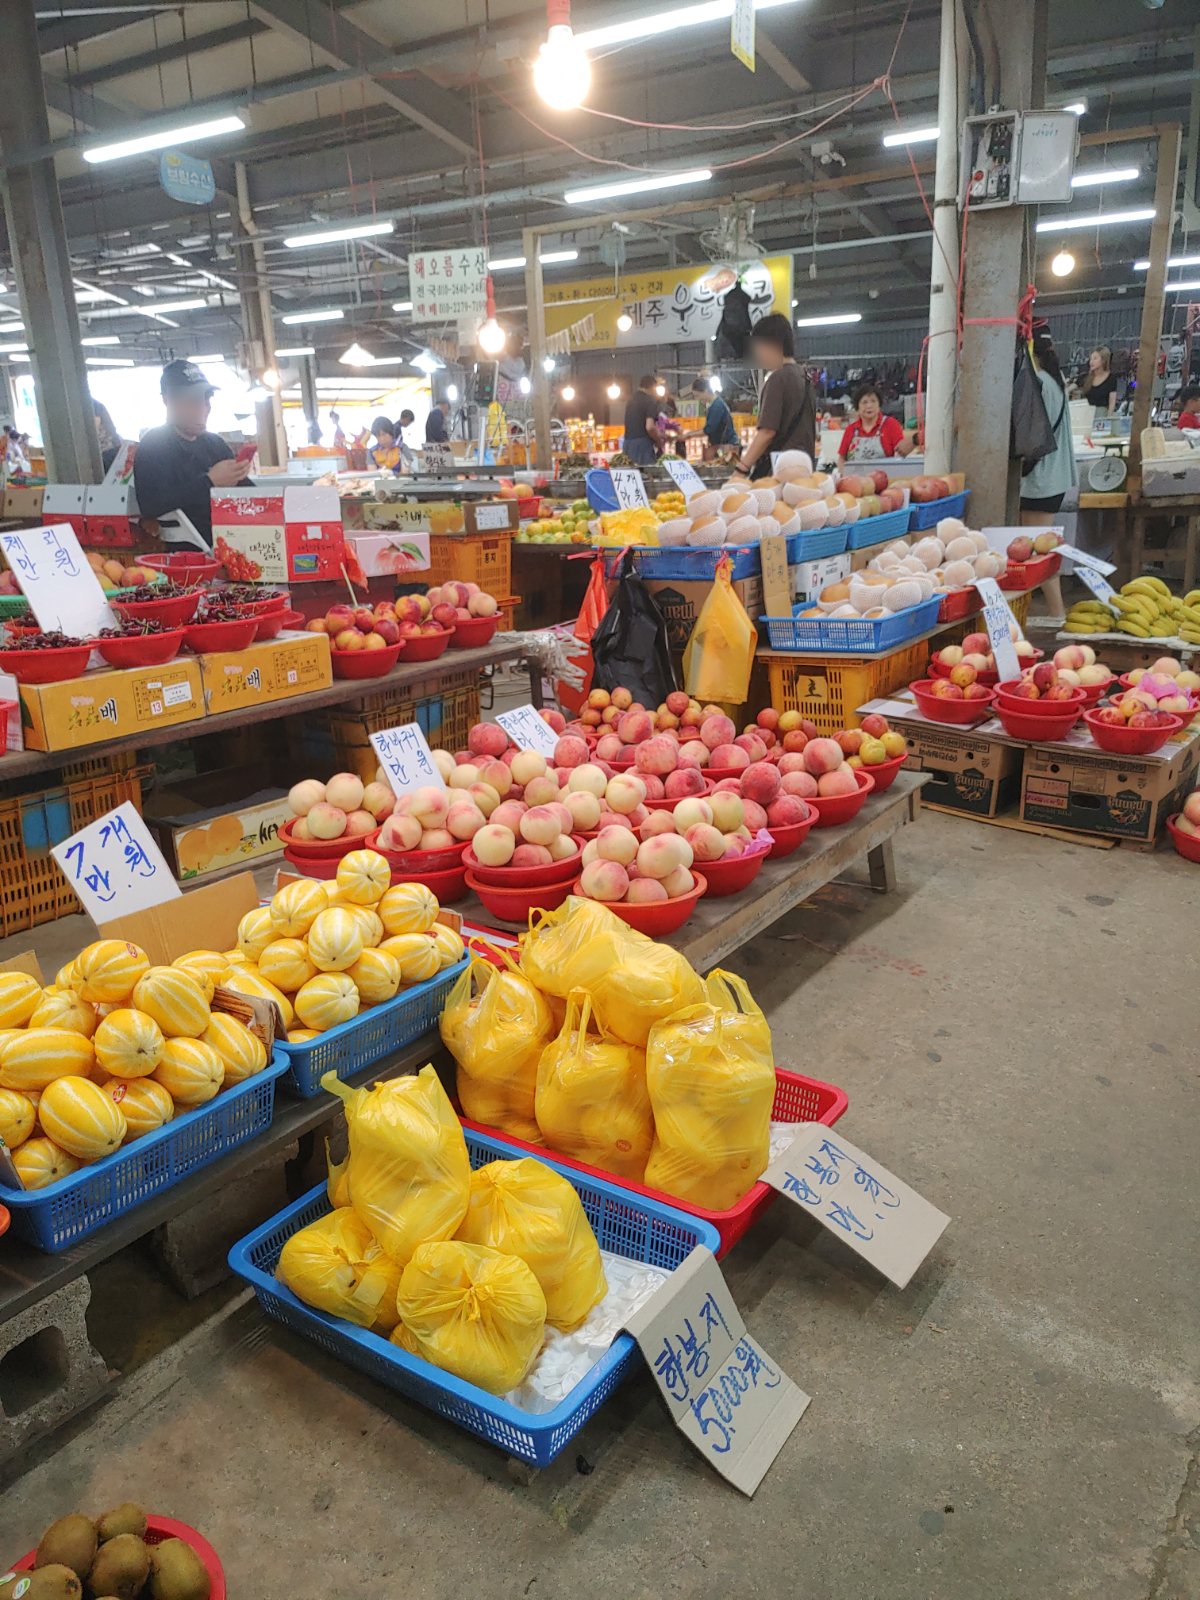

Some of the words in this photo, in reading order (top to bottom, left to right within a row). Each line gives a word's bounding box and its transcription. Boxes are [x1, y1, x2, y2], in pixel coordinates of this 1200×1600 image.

[663, 603, 694, 621] man
[289, 672, 296, 682] 12
[152, 701, 162, 713] 13
[954, 773, 992, 790] manna
[1106, 796, 1148, 812] manna
[65, 815, 133, 880] 7개
[782, 1138, 862, 1206] 한봉지
[654, 1292, 734, 1402] 한봉지
